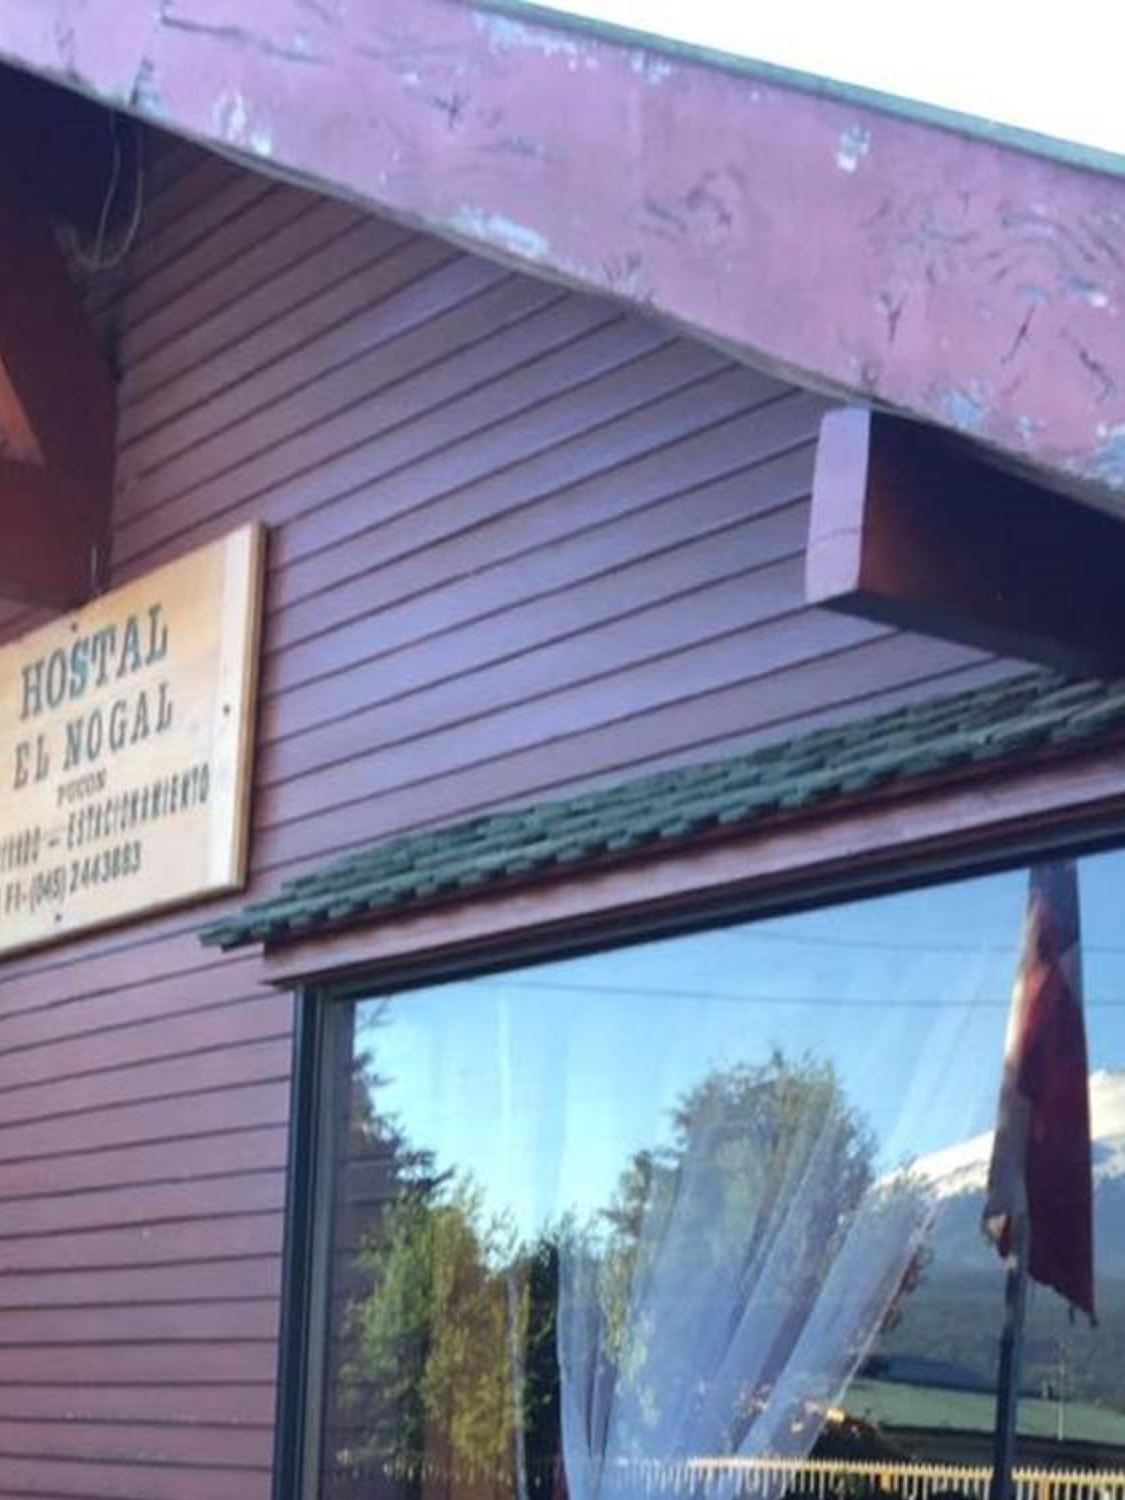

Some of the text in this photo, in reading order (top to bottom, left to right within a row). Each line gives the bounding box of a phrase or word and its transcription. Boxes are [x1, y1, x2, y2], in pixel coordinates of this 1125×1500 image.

[19, 602, 169, 721] HOSTAL
[13, 681, 173, 790] EL NOGAL
[67, 762, 210, 851] ESTACIONAMIENTO
